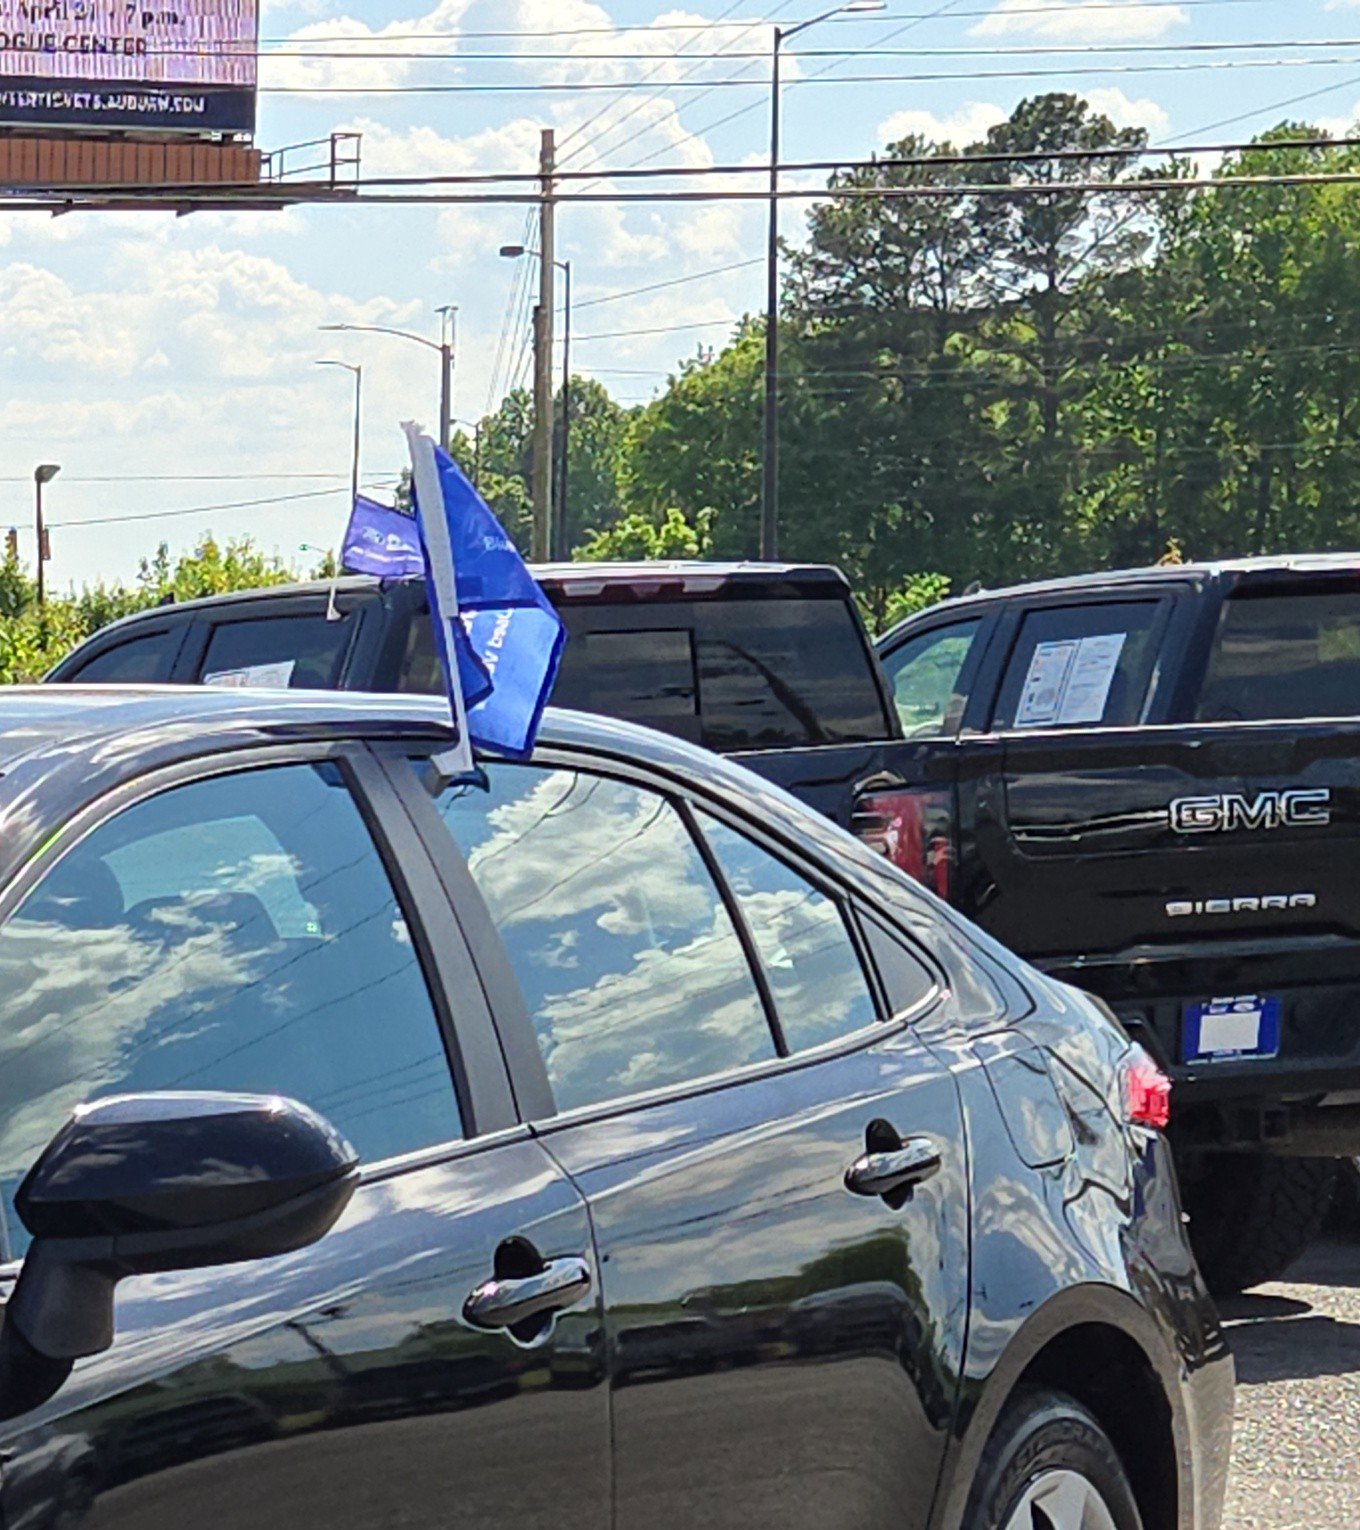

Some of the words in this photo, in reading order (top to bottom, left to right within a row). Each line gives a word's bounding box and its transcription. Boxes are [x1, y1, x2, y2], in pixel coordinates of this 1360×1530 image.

[63, 34, 147, 57] CENTER
[1169, 787, 1330, 834] GMC
[1165, 893, 1317, 918] SIERRA
